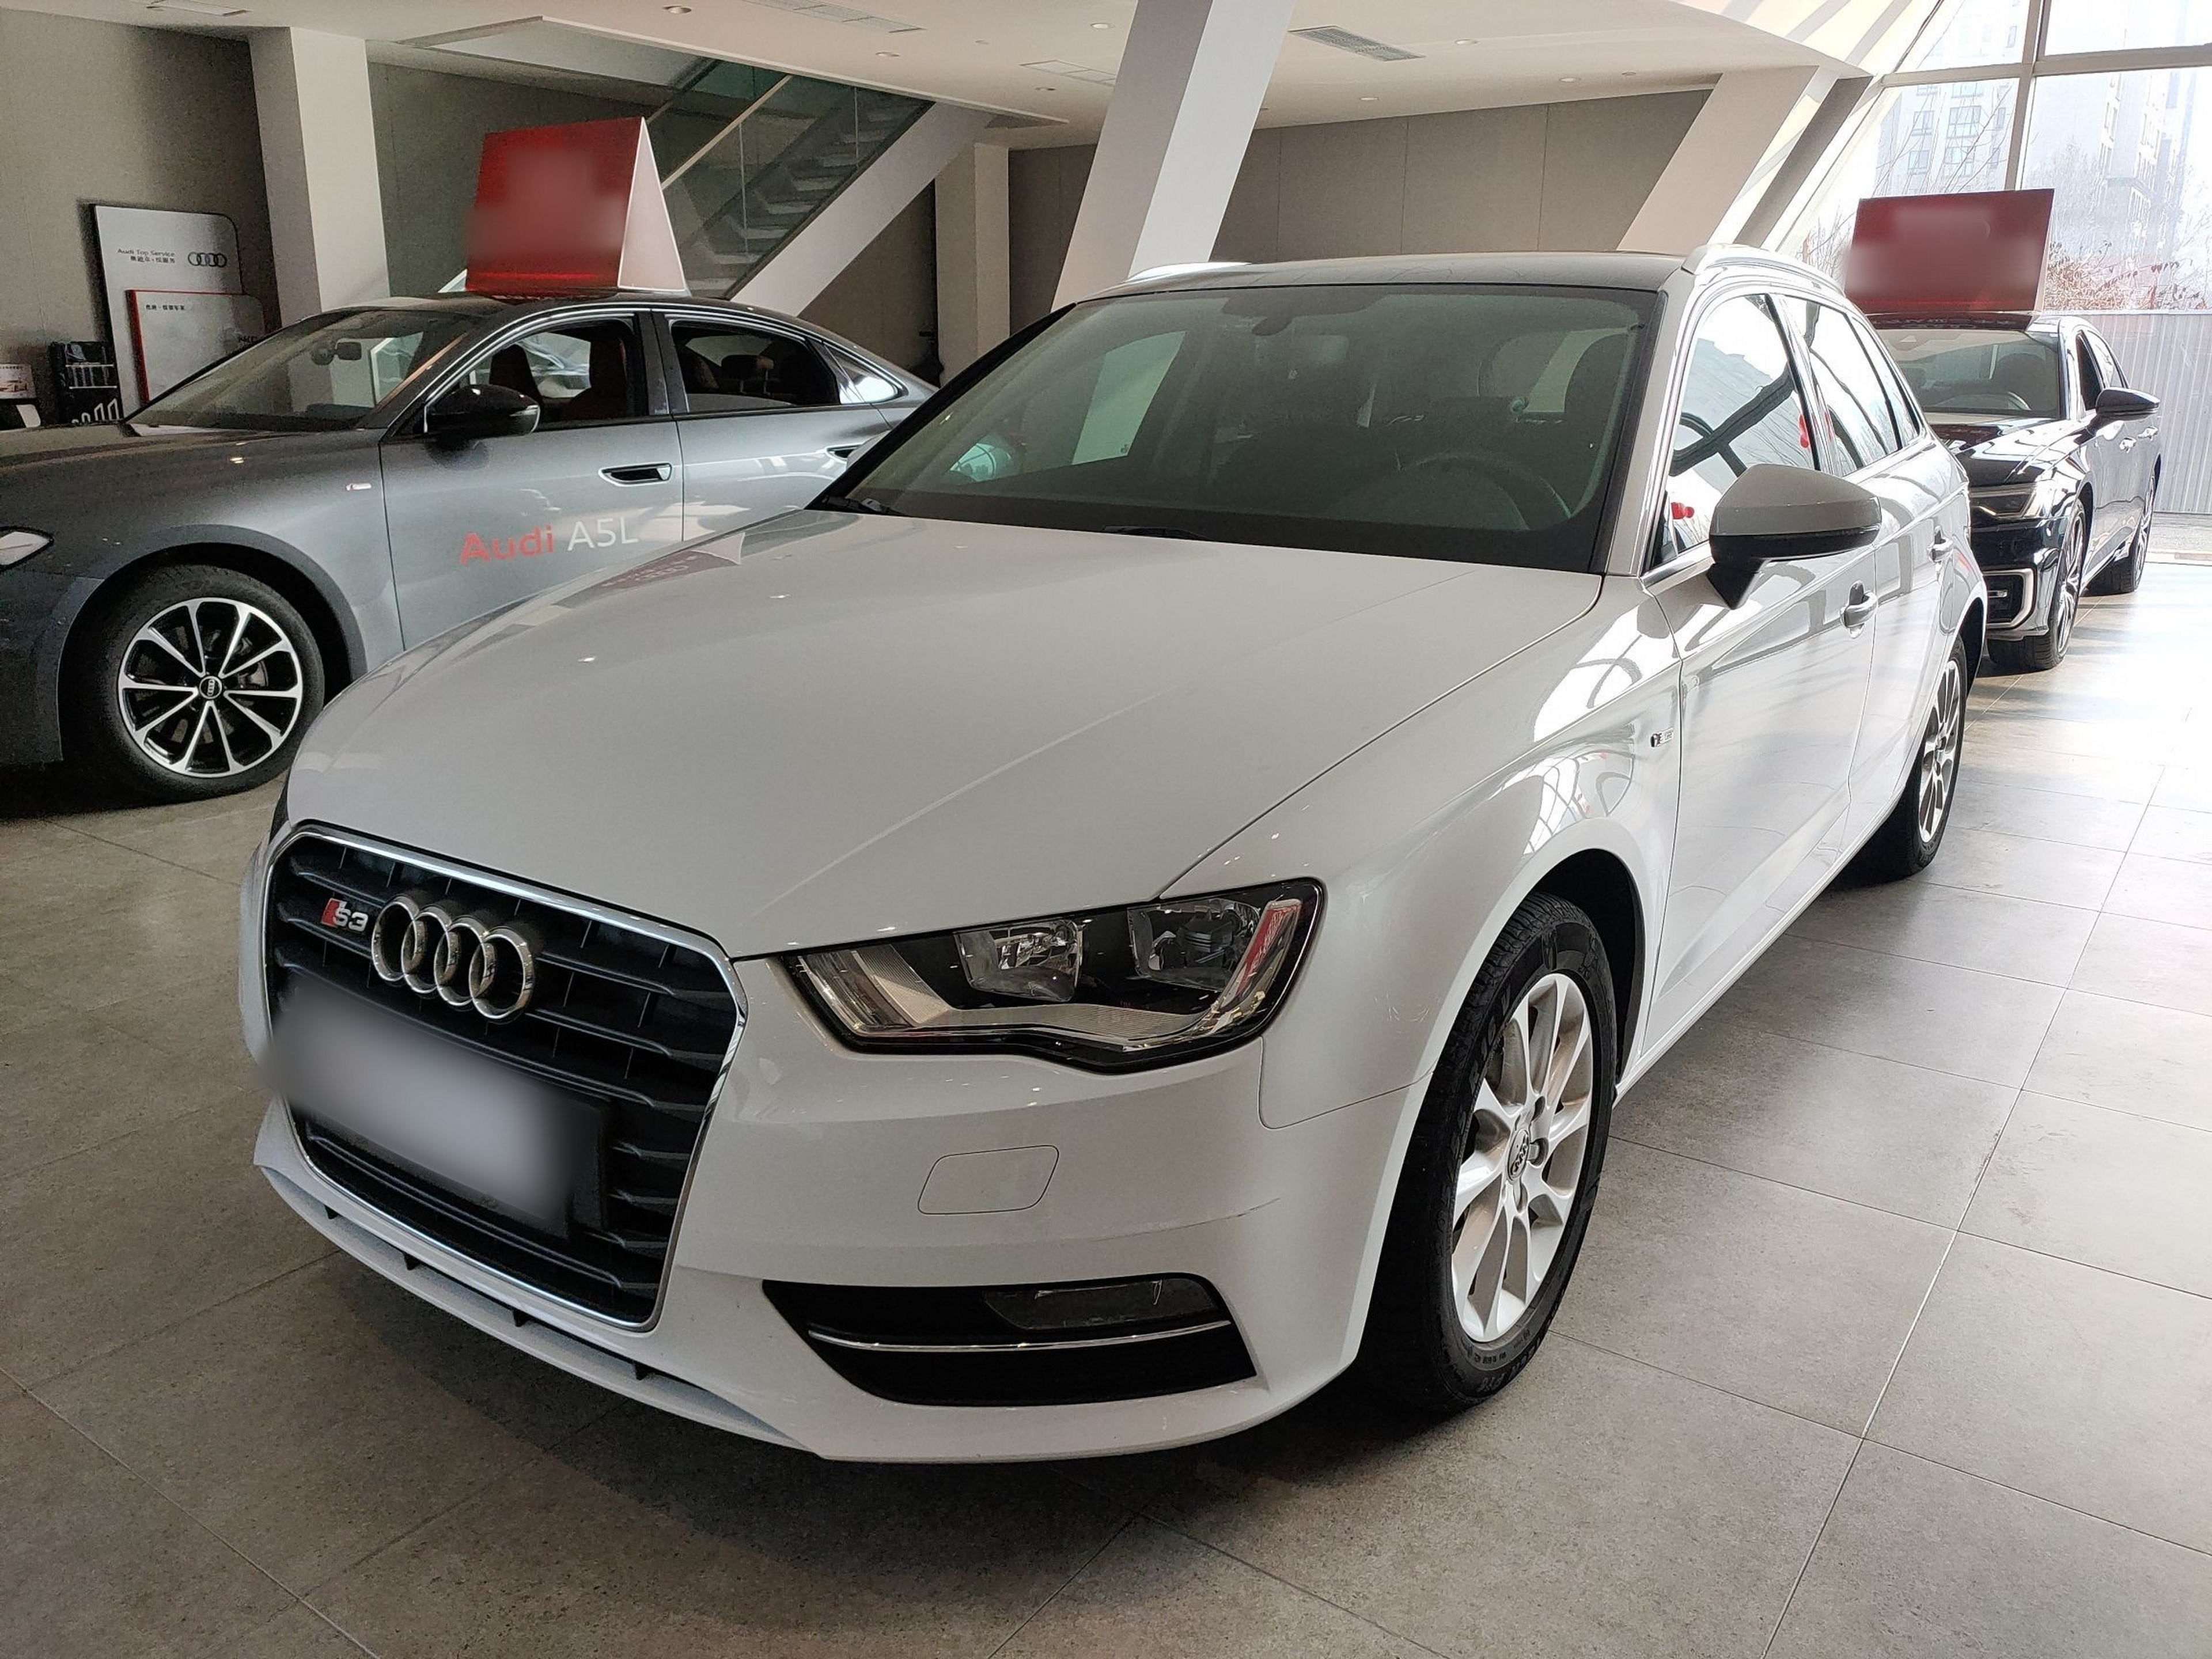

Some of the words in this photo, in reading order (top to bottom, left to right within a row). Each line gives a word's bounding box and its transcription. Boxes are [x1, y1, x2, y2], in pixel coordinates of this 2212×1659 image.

[460, 524, 554, 565] Audi
[567, 518, 638, 551] A5L
[332, 906, 369, 931] S3
